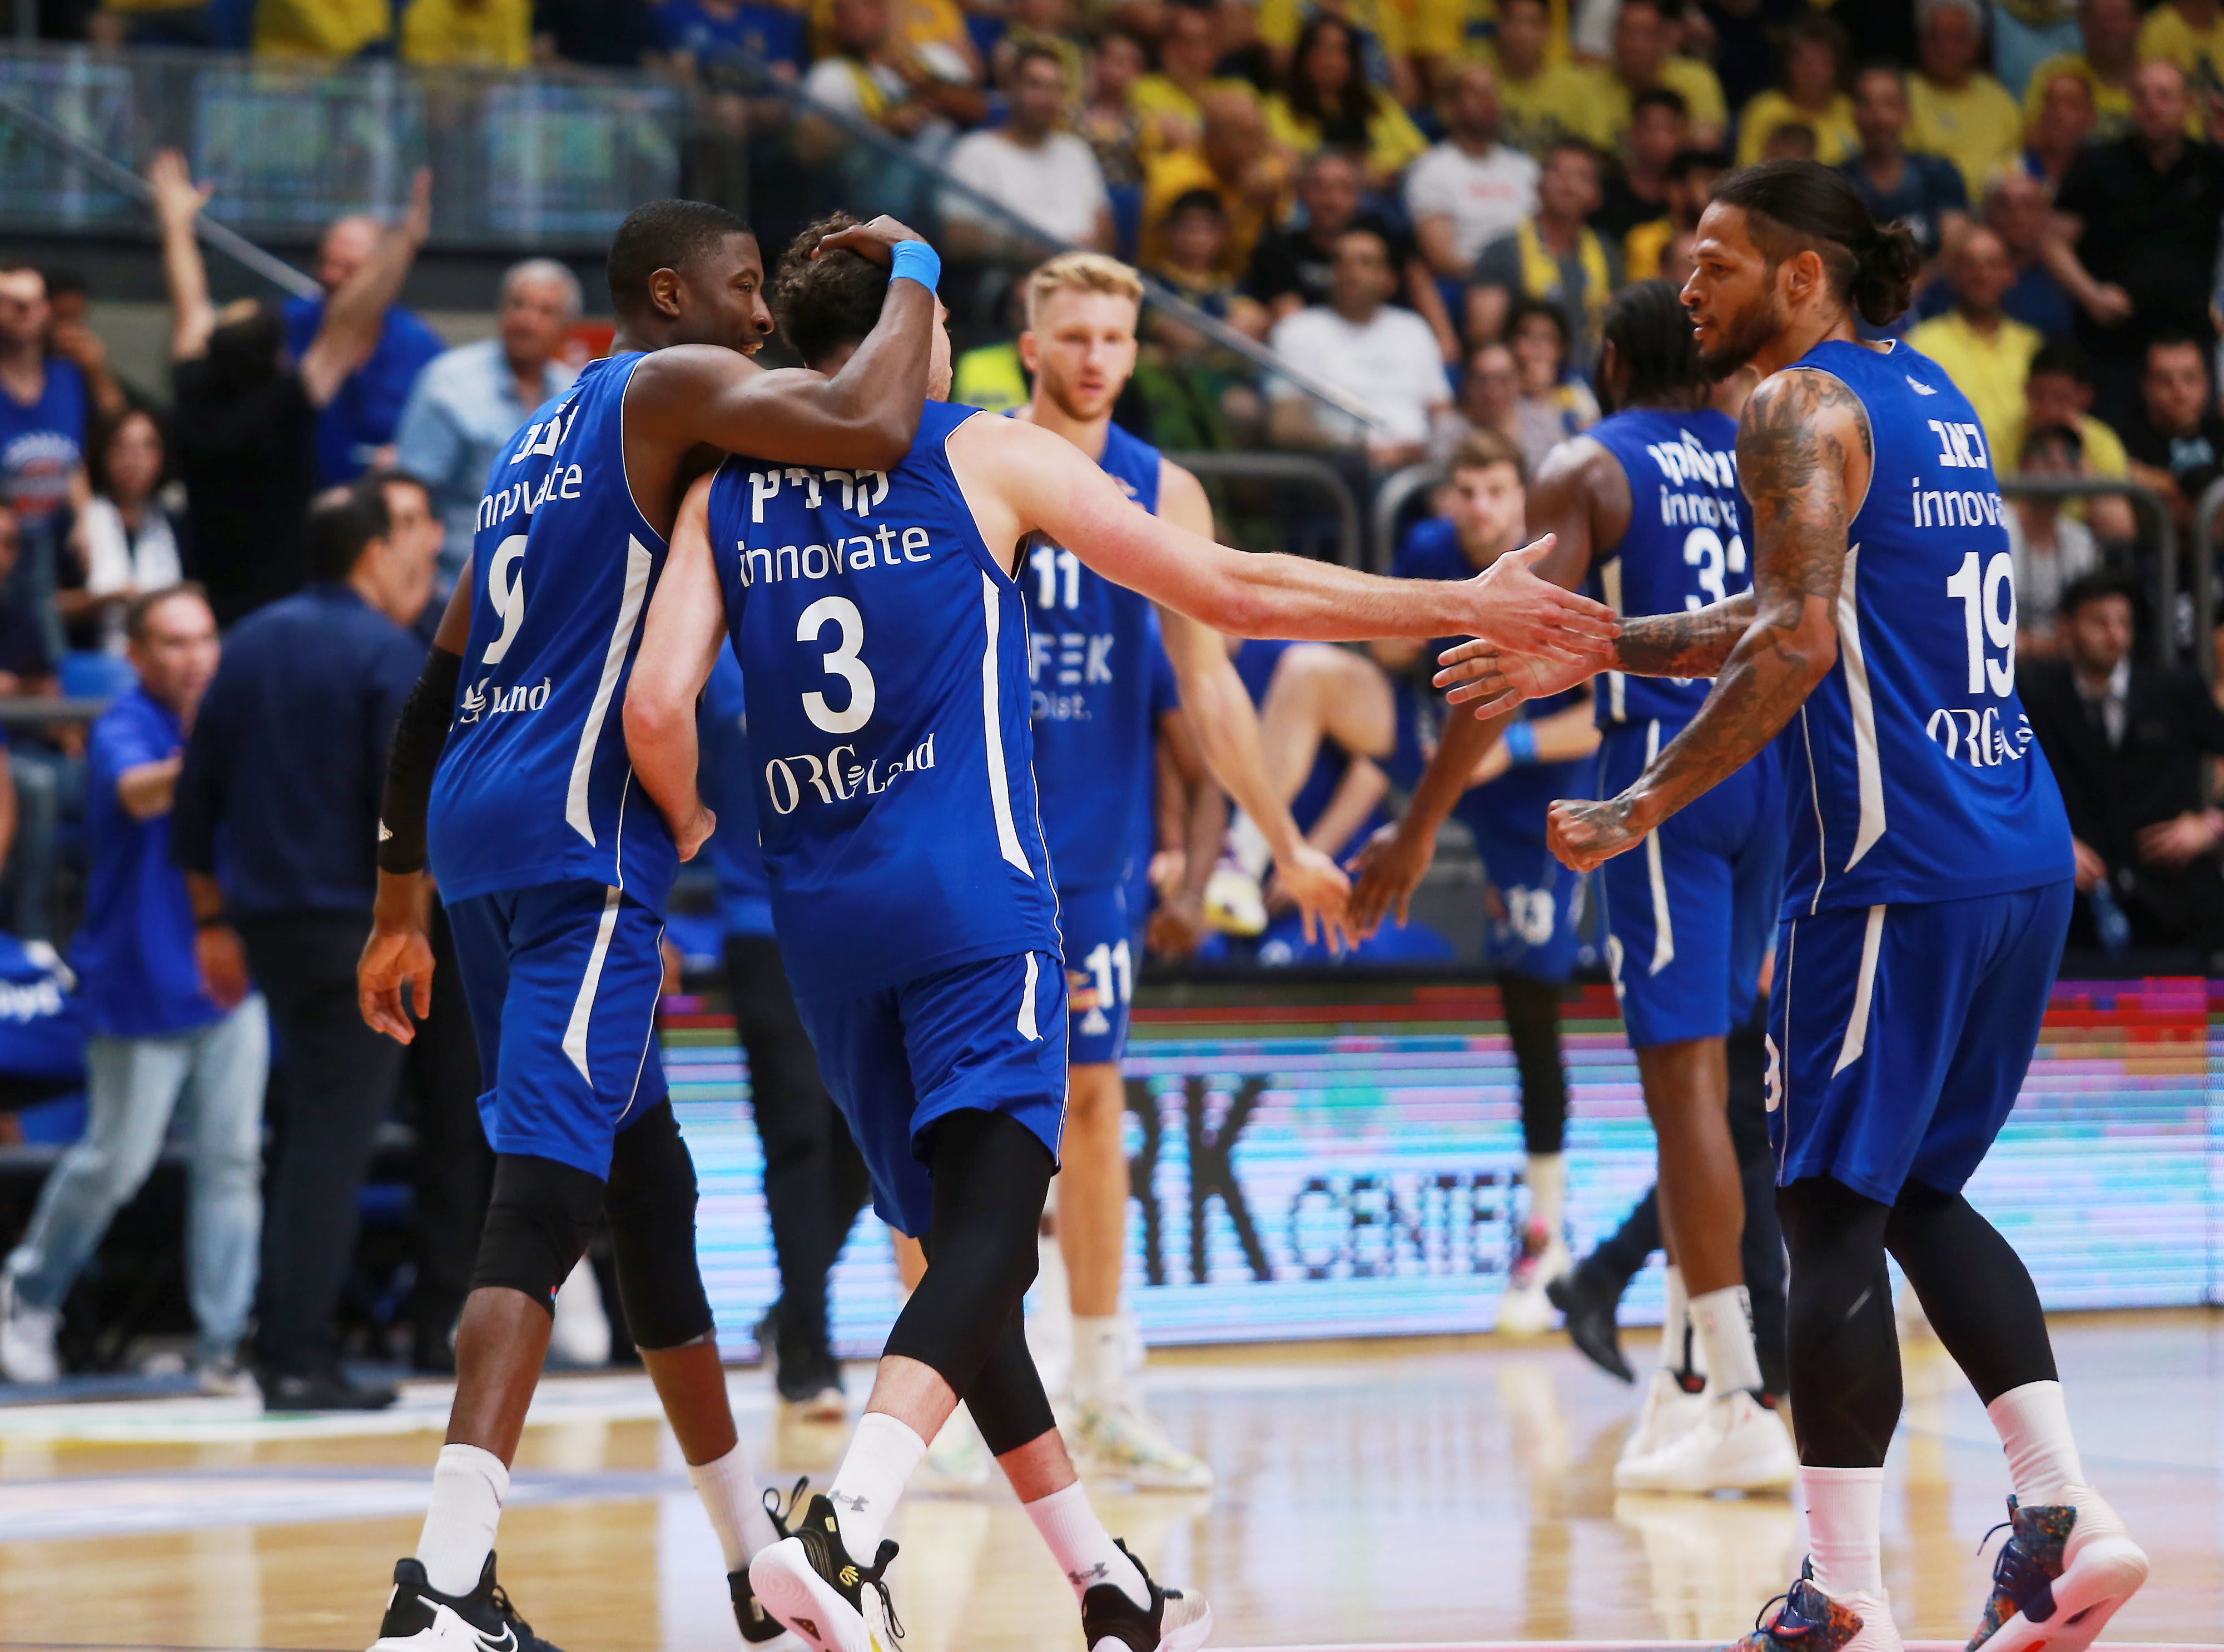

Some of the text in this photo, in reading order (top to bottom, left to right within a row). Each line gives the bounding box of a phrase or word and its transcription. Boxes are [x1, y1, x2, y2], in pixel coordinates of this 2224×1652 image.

[474, 461, 583, 534] nnovate
[737, 524, 931, 587] innovate
[1030, 545, 1080, 610] 11
[483, 534, 528, 664] 9
[1947, 551, 2017, 698] 19
[796, 596, 876, 734] 3
[1030, 632, 1115, 685] FEK
[1085, 938, 1132, 1009] 11
[1123, 1075, 1528, 1285] RK CENTE
